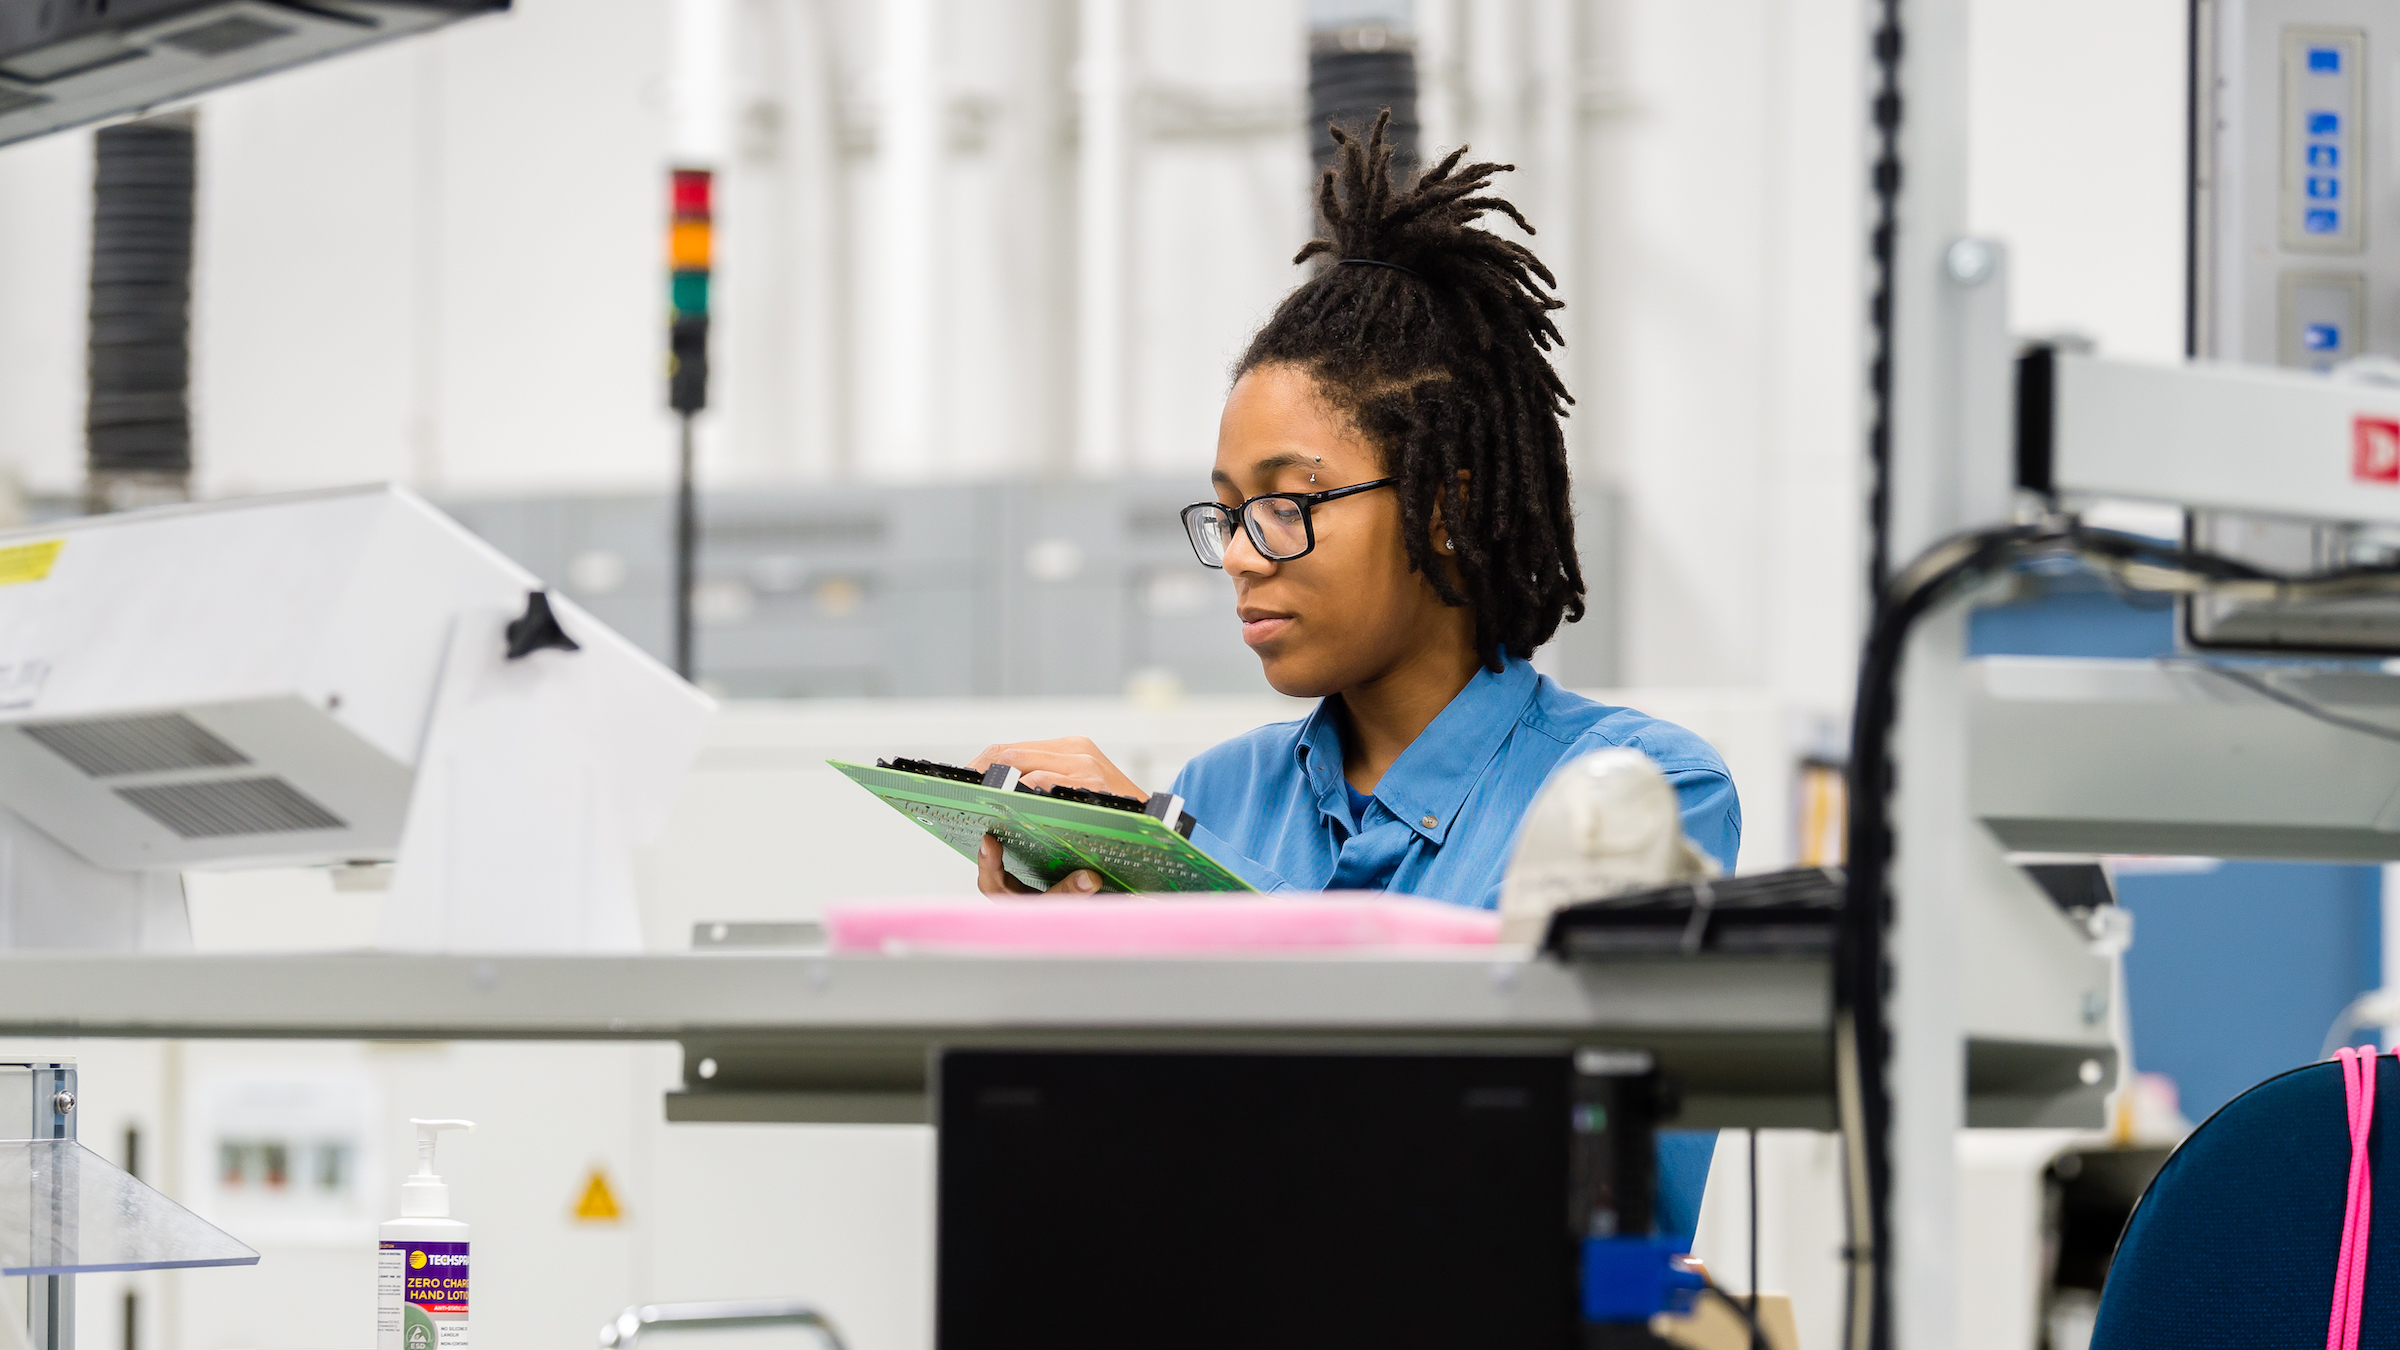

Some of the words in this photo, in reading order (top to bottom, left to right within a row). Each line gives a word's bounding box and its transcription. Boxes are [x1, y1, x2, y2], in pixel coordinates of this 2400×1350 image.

[407, 1278, 440, 1287] ZERO
[410, 1290, 445, 1299] HAND
[410, 1342, 426, 1350] ESD
